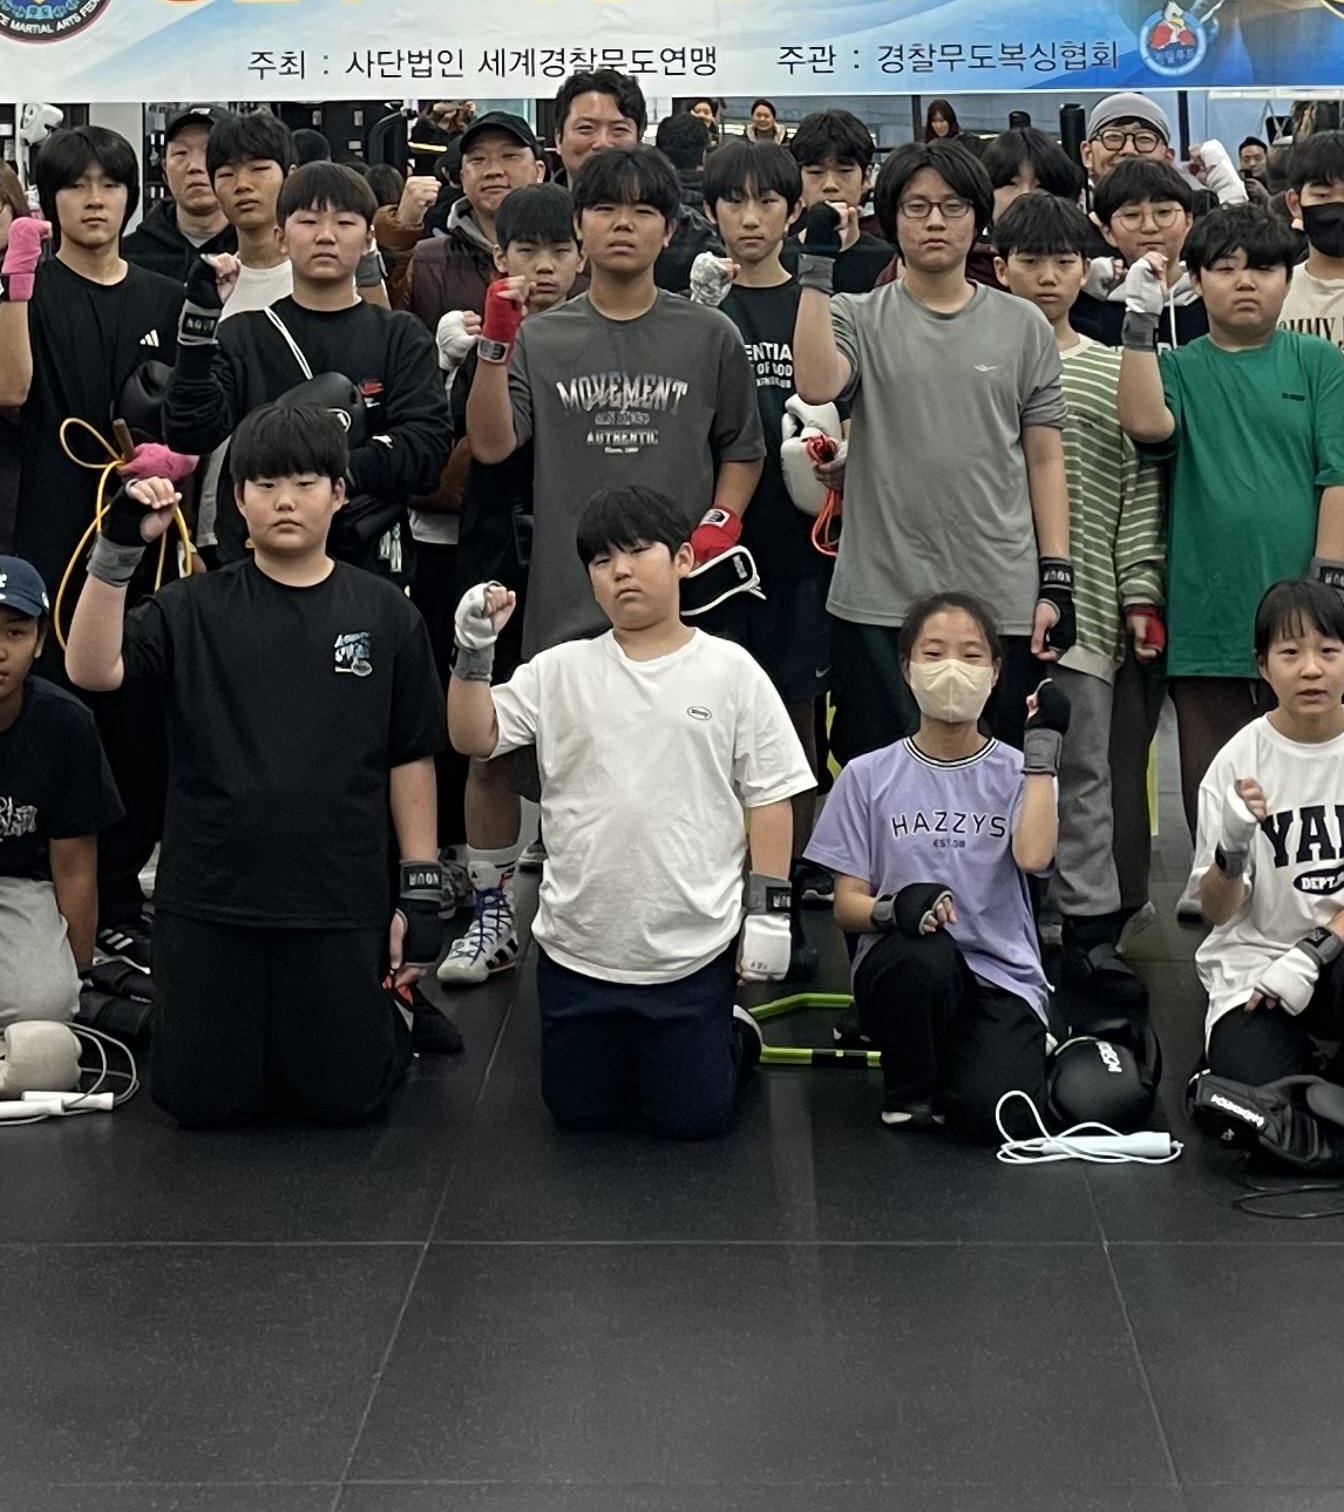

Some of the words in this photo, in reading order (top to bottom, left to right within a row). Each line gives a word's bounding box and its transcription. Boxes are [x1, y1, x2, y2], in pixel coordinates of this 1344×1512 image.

[9, 18, 55, 34] MARTIAL
[56, 11, 82, 31] ARTS
[247, 49, 307, 80] 주최
[345, 47, 465, 79] 사단법인
[776, 43, 837, 76] 주관
[877, 40, 1119, 74] 경찰무도복싱협회
[555, 371, 689, 416] MOVEMENT
[586, 430, 659, 445] AUTHENTIC
[891, 810, 1007, 839] HAZZYS
